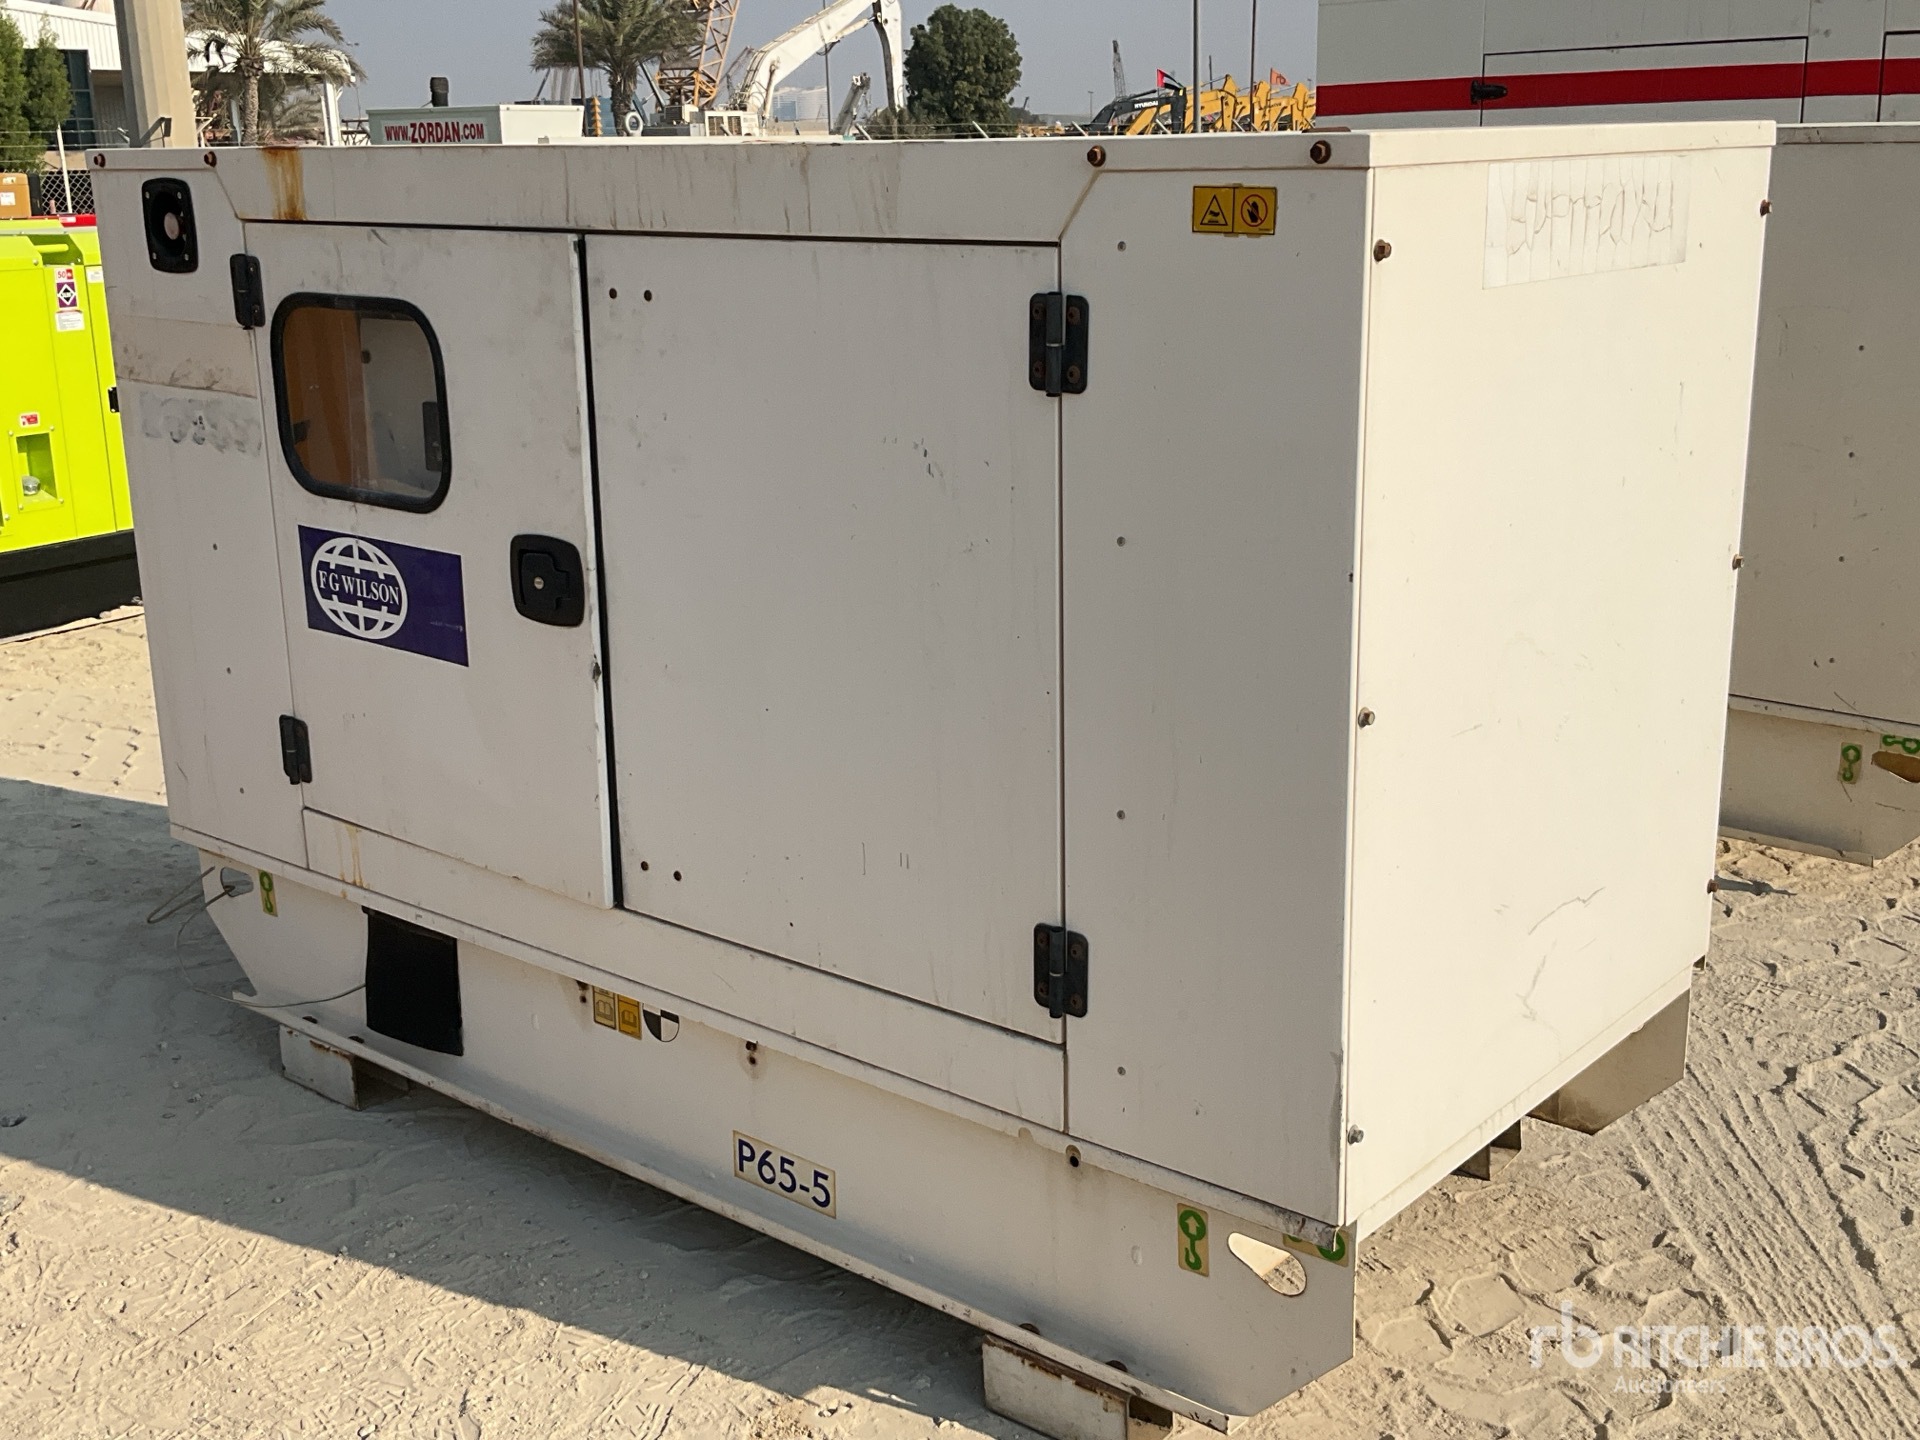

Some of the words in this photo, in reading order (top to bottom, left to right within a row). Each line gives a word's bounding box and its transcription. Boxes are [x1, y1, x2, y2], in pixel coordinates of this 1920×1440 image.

[384, 121, 484, 143] WWW.ZORDAN.COM
[341, 574, 400, 605] WILSON
[738, 1138, 831, 1208] P65-5
